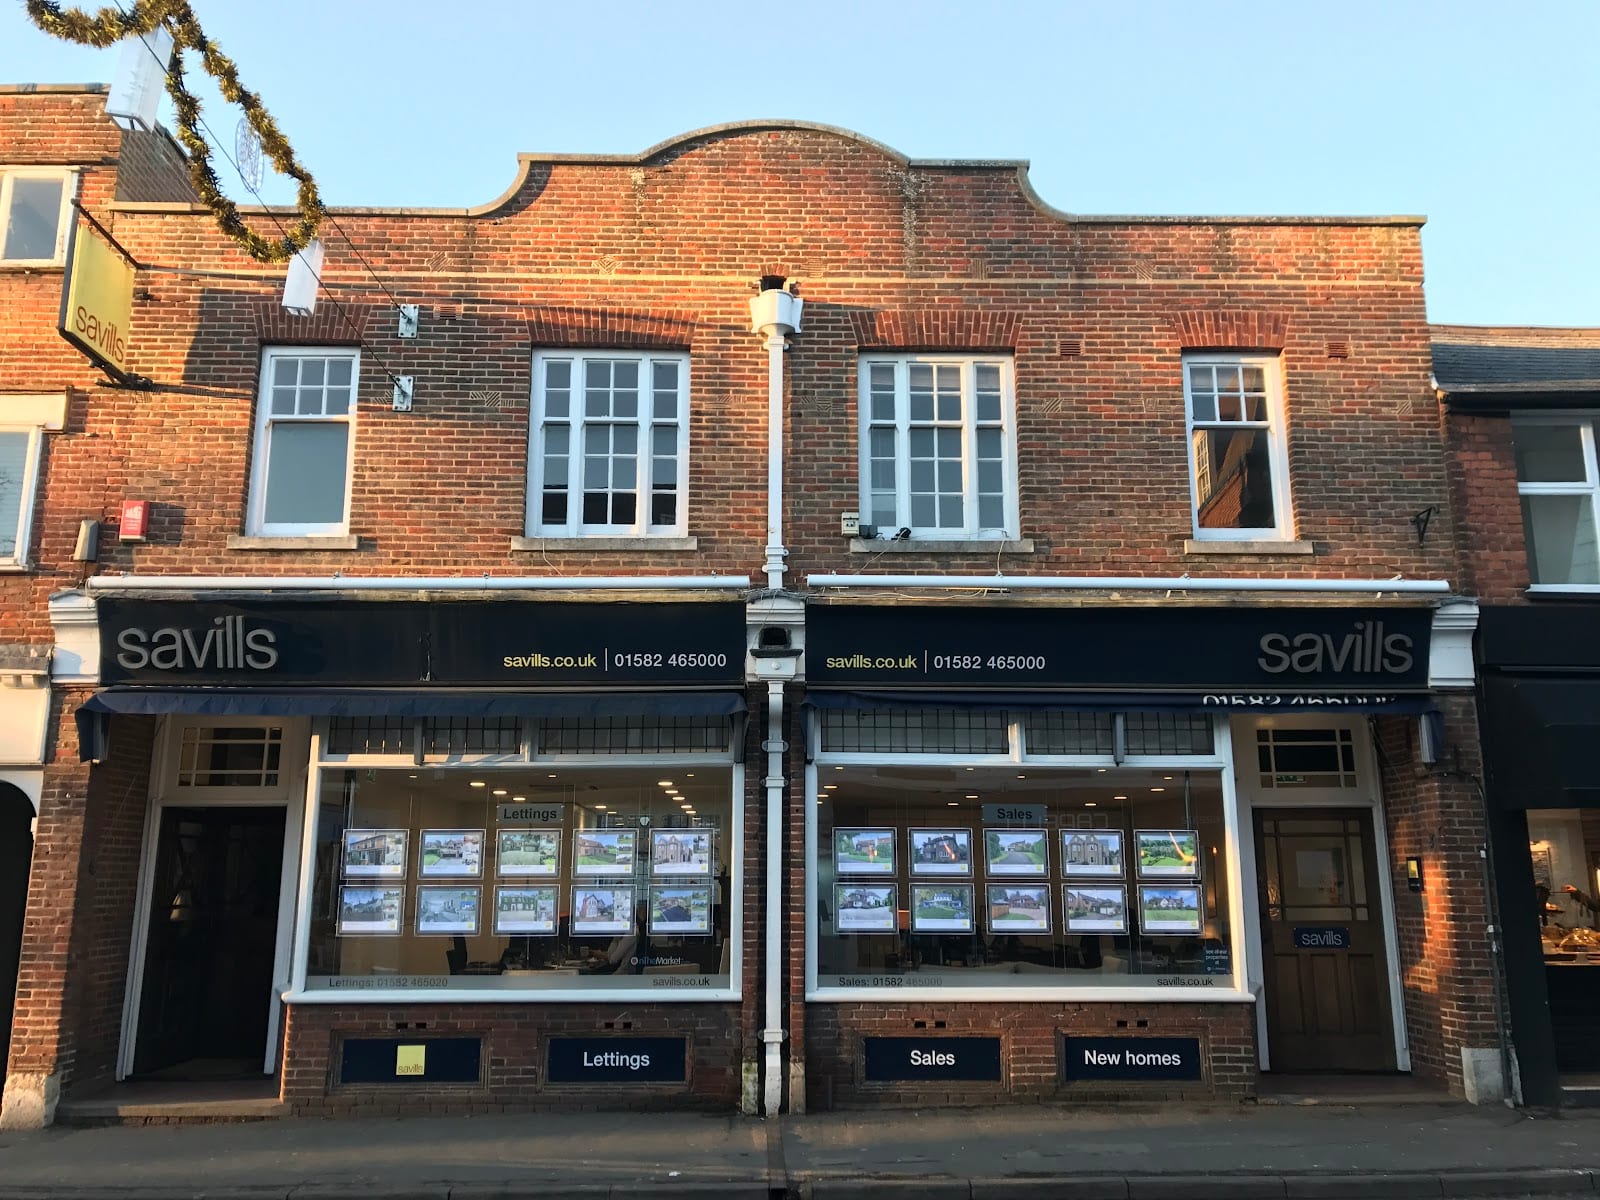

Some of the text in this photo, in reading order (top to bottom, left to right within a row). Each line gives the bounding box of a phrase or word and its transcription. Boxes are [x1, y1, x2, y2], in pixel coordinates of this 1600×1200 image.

[76, 305, 125, 363] savills
[117, 615, 279, 669] savills
[1257, 620, 1414, 673] savills
[503, 653, 727, 667] savills.co.uk 01582 465000
[826, 654, 1046, 669] savills.co.uk 01582 465000
[503, 807, 558, 821] Lettings
[997, 808, 1033, 819] Sales
[1301, 930, 1343, 945] savills
[328, 977, 374, 989] Lettings:
[652, 976, 711, 987] savills.co.uk
[838, 976, 870, 987] Sales:
[872, 977, 903, 987] 01582
[1156, 976, 1214, 986] savills.co.uk
[583, 1051, 650, 1070] Lettings
[909, 1050, 956, 1066] Sales
[1084, 1049, 1181, 1066] New homes
[398, 1063, 424, 1074] savills
